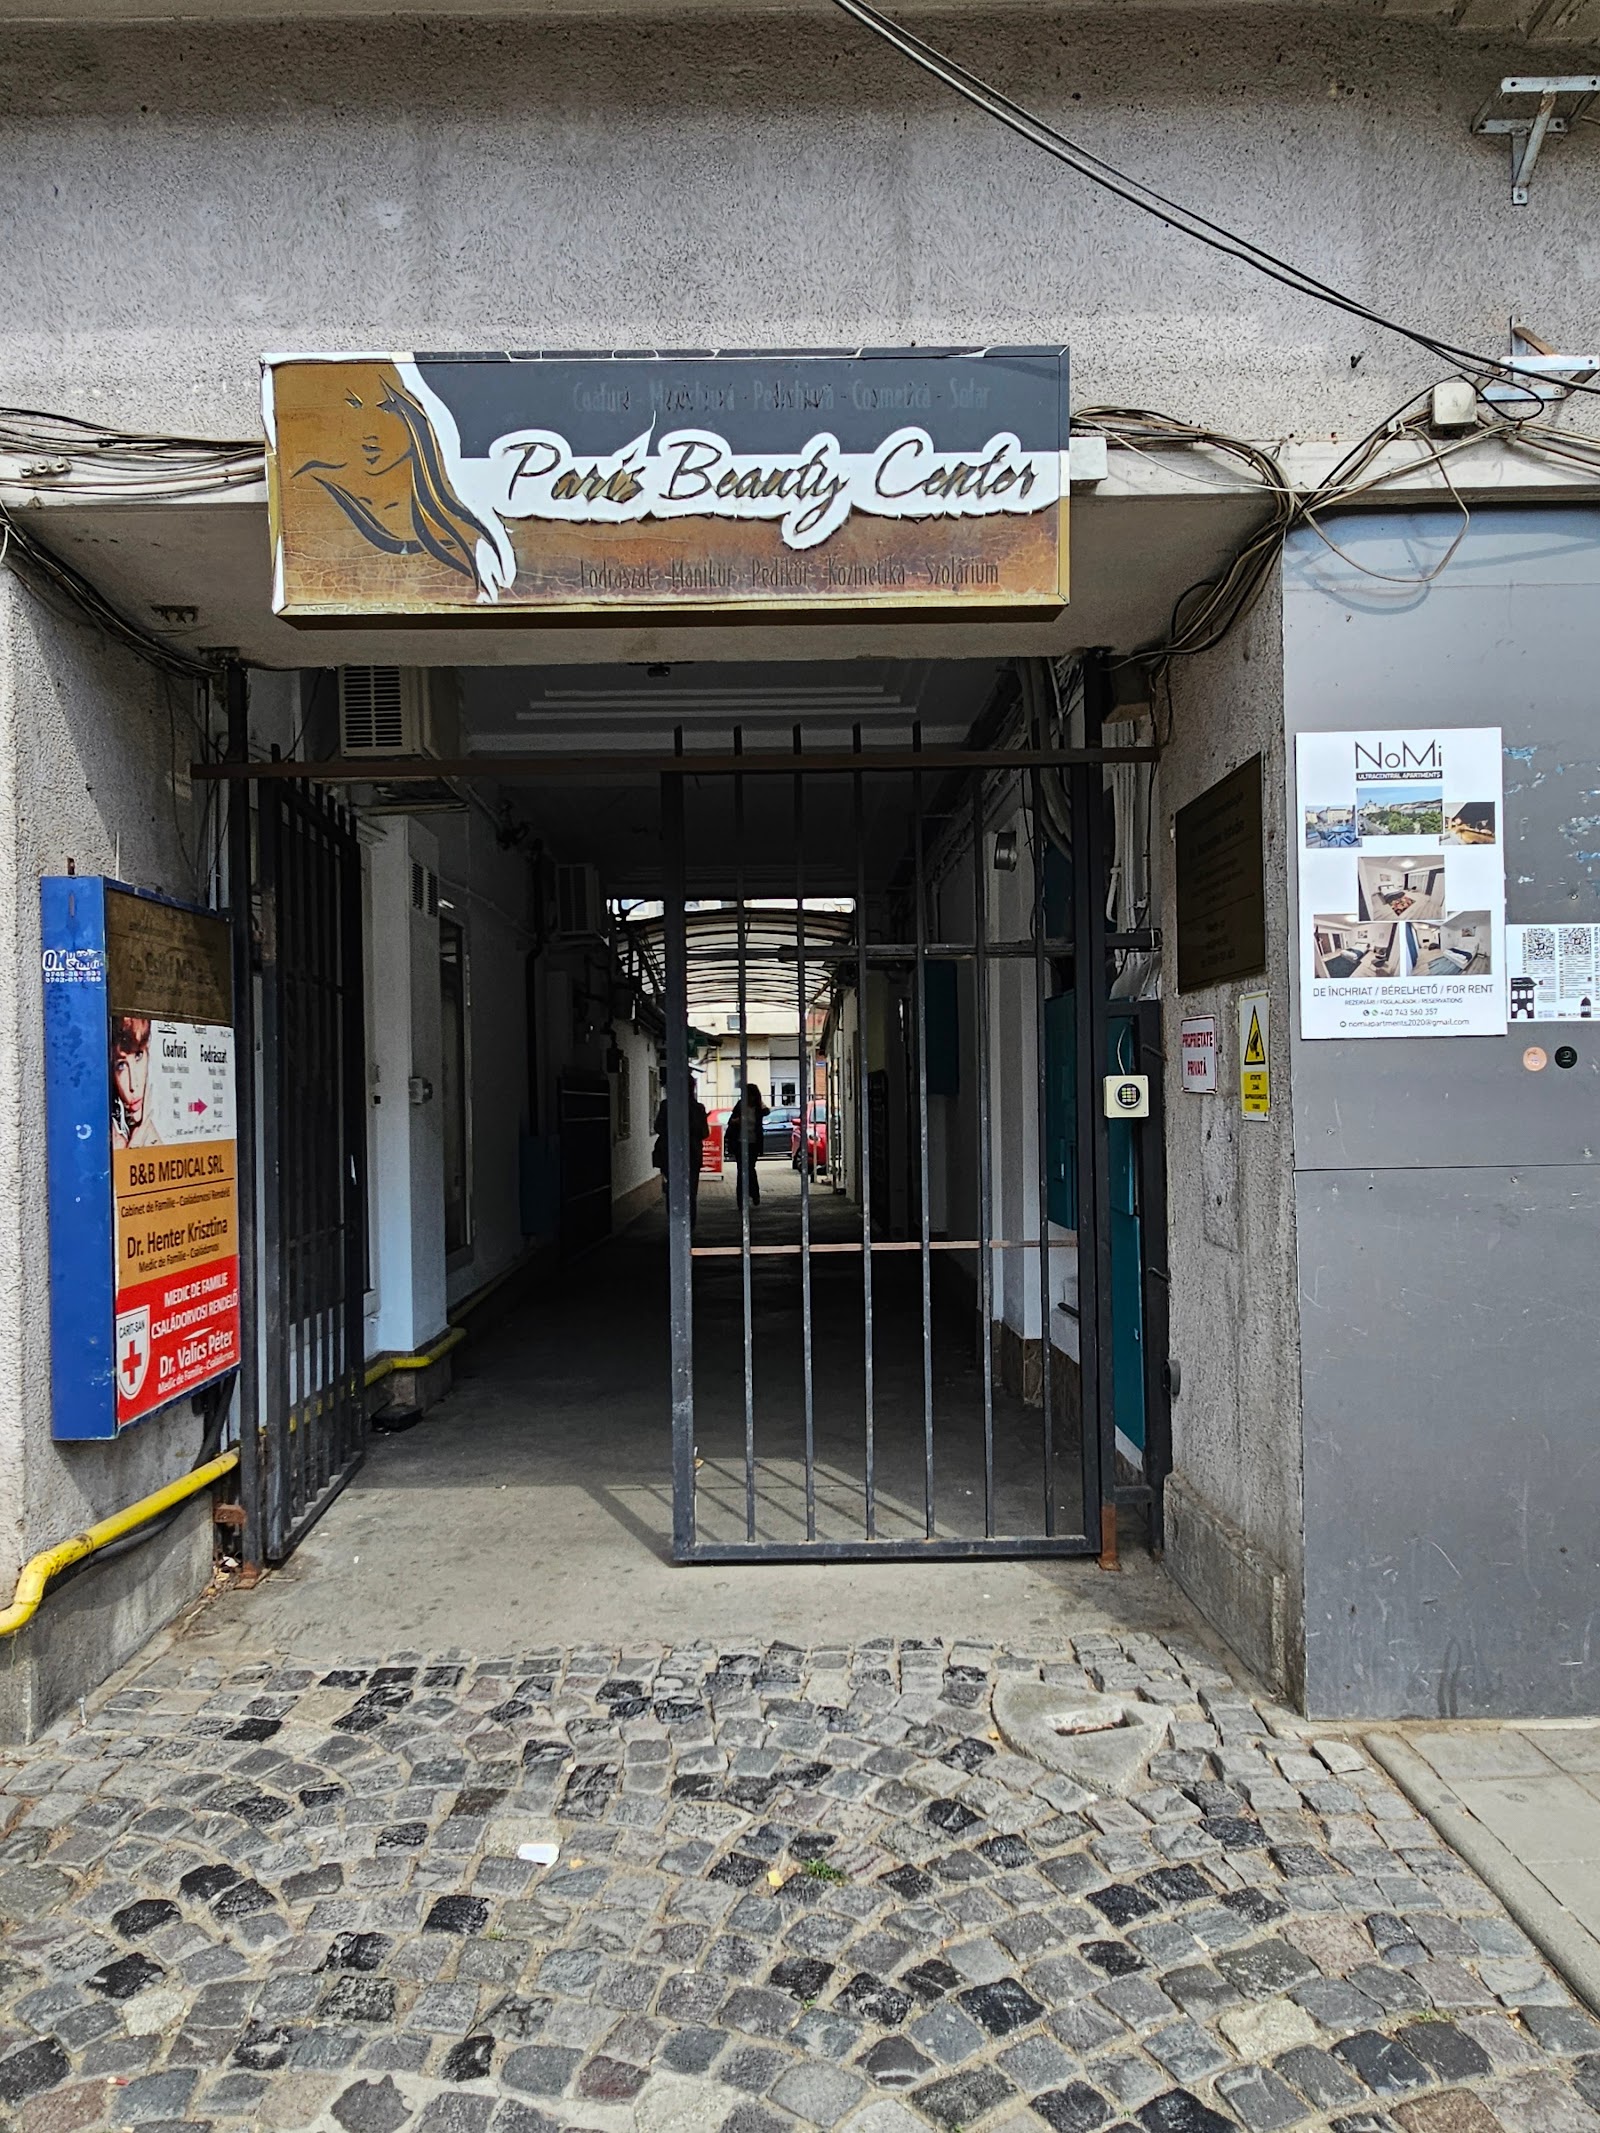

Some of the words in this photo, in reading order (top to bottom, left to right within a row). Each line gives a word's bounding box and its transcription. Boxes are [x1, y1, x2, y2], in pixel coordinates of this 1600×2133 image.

[502, 441, 647, 503] Paris
[659, 440, 850, 535] Beauty
[875, 438, 1038, 499] Center
[1355, 740, 1442, 769] NoMi
[1358, 772, 1401, 780] ULTRACENTRAL
[1313, 988, 1326, 996] DE
[1328, 986, 1372, 996] ÎNCHRIAT
[1446, 985, 1465, 994] FOR
[1468, 984, 1494, 994] RENT
[163, 1038, 187, 1059] Coafură
[1182, 1032, 1212, 1048] PROPRIETATE
[130, 1163, 155, 1186] B&B
[159, 1157, 206, 1182] MEDICAL
[208, 1155, 224, 1175] SRL
[121, 1204, 146, 1218] Cabinet
[146, 1202, 153, 1213] de
[155, 1198, 175, 1210] Familie
[128, 1236, 144, 1259] Dr.
[148, 1229, 185, 1253] Henter
[188, 1217, 227, 1243] Krisztina
[139, 1259, 157, 1273] Medic
[164, 1284, 190, 1308] MEDIC
[191, 1281, 201, 1297] DE
[202, 1272, 228, 1294] FAMILIE
[160, 1356, 176, 1378] Dr.
[177, 1341, 207, 1368] Valics
[208, 1330, 233, 1354] Péter
[158, 1379, 175, 1394] Medic
